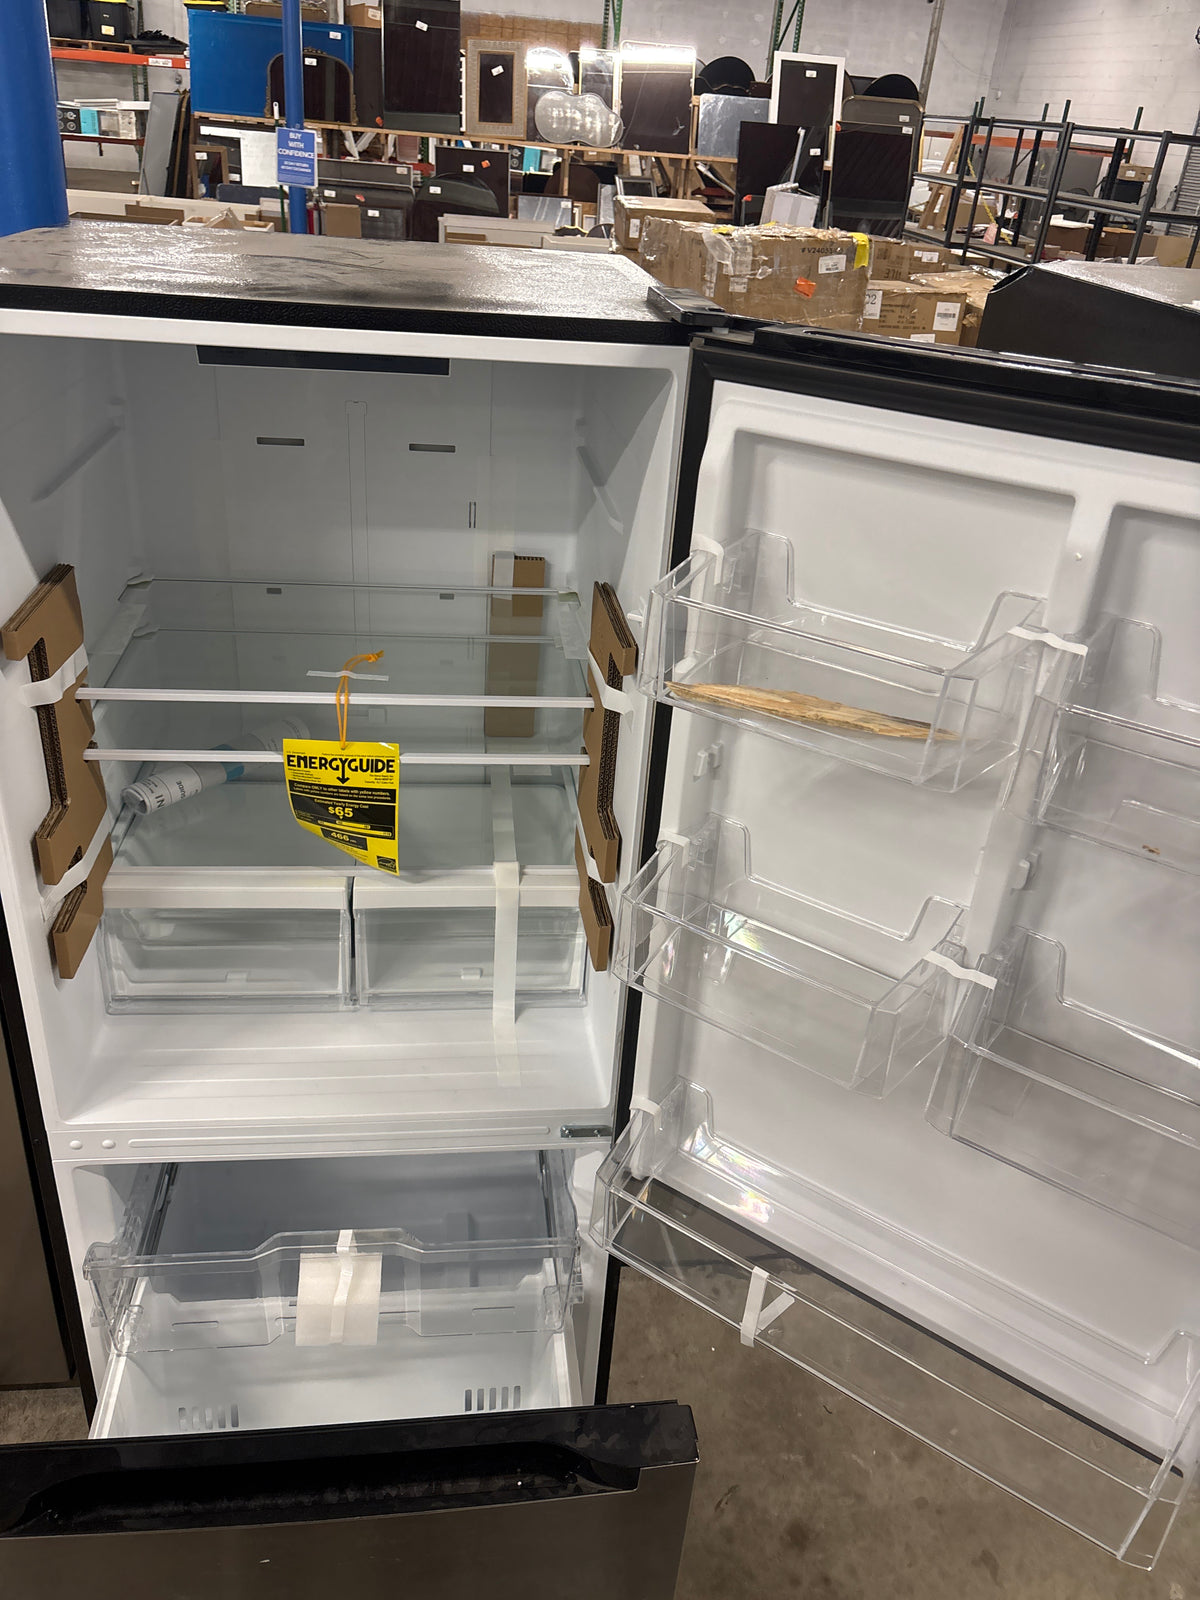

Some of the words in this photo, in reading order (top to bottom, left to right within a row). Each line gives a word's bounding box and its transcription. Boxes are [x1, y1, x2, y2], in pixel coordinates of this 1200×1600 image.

[278, 148, 315, 159] CONFIDENCE
[287, 755, 395, 773] ENERGYGUIDE
[328, 806, 354, 818] $65
